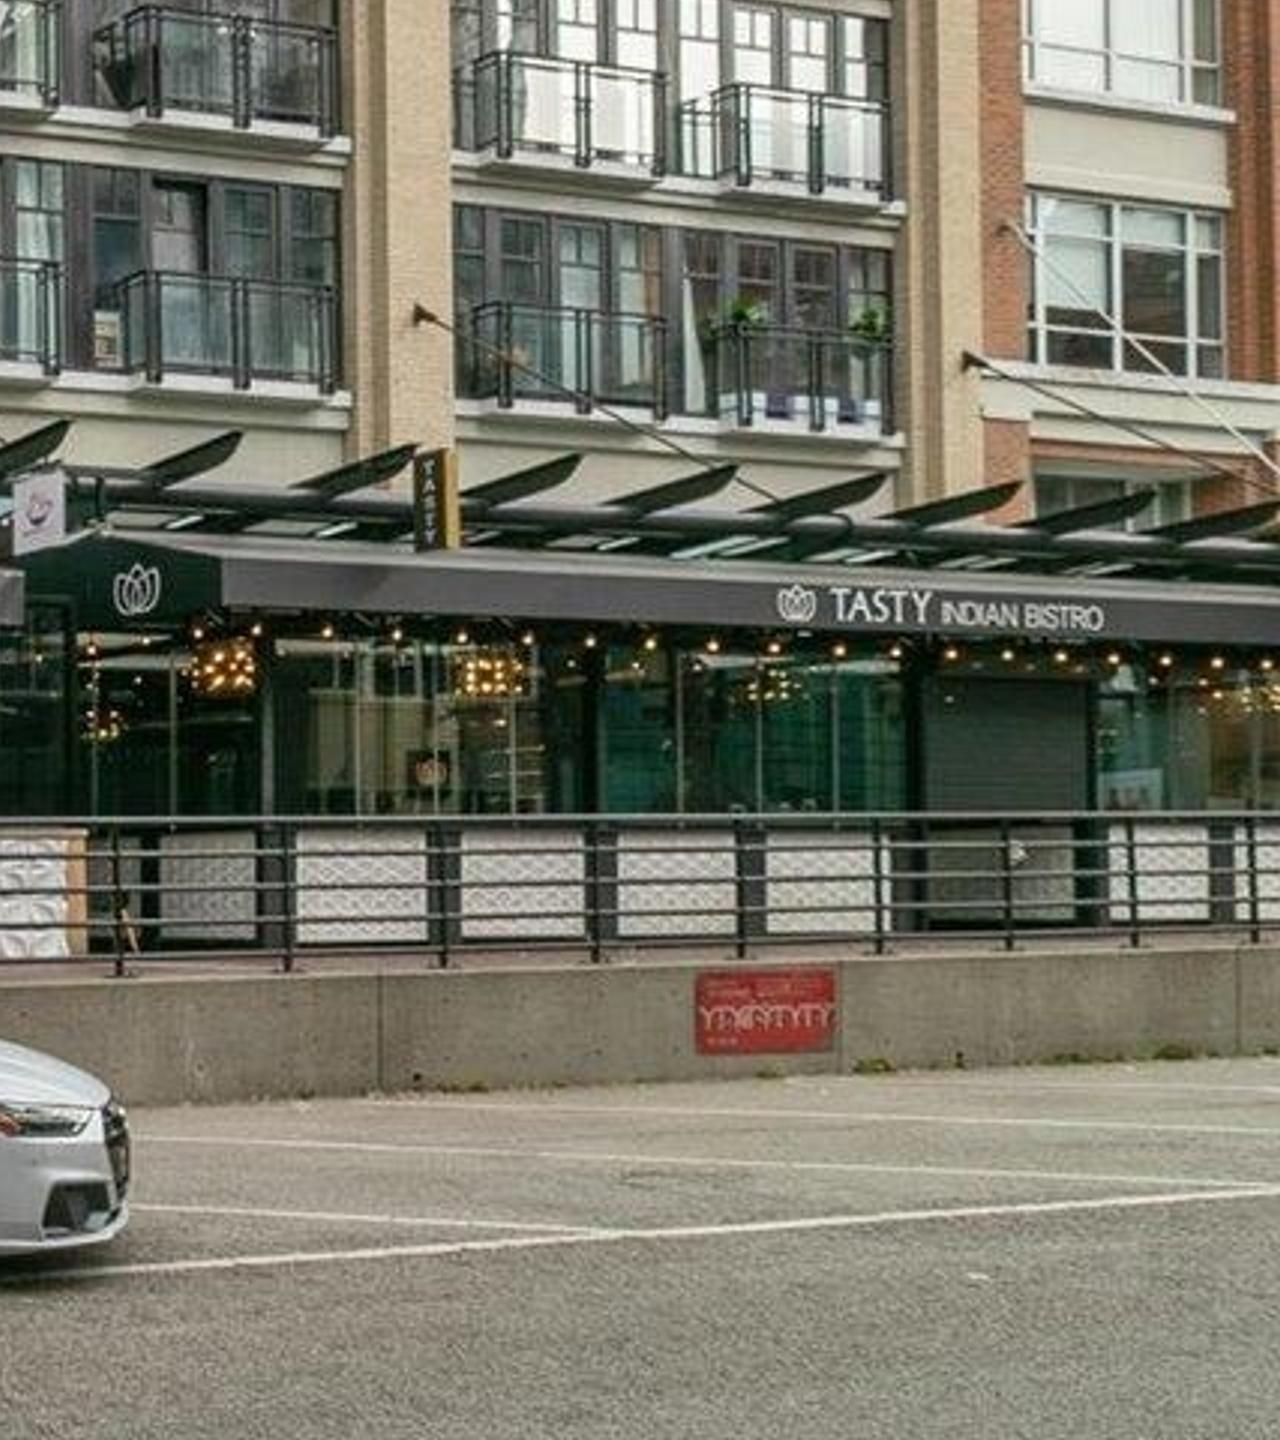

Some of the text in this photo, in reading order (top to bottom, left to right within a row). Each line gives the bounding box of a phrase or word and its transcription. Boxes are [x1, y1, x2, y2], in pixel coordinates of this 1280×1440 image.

[830, 587, 1105, 631] TASTY INDIAN BISTRO
